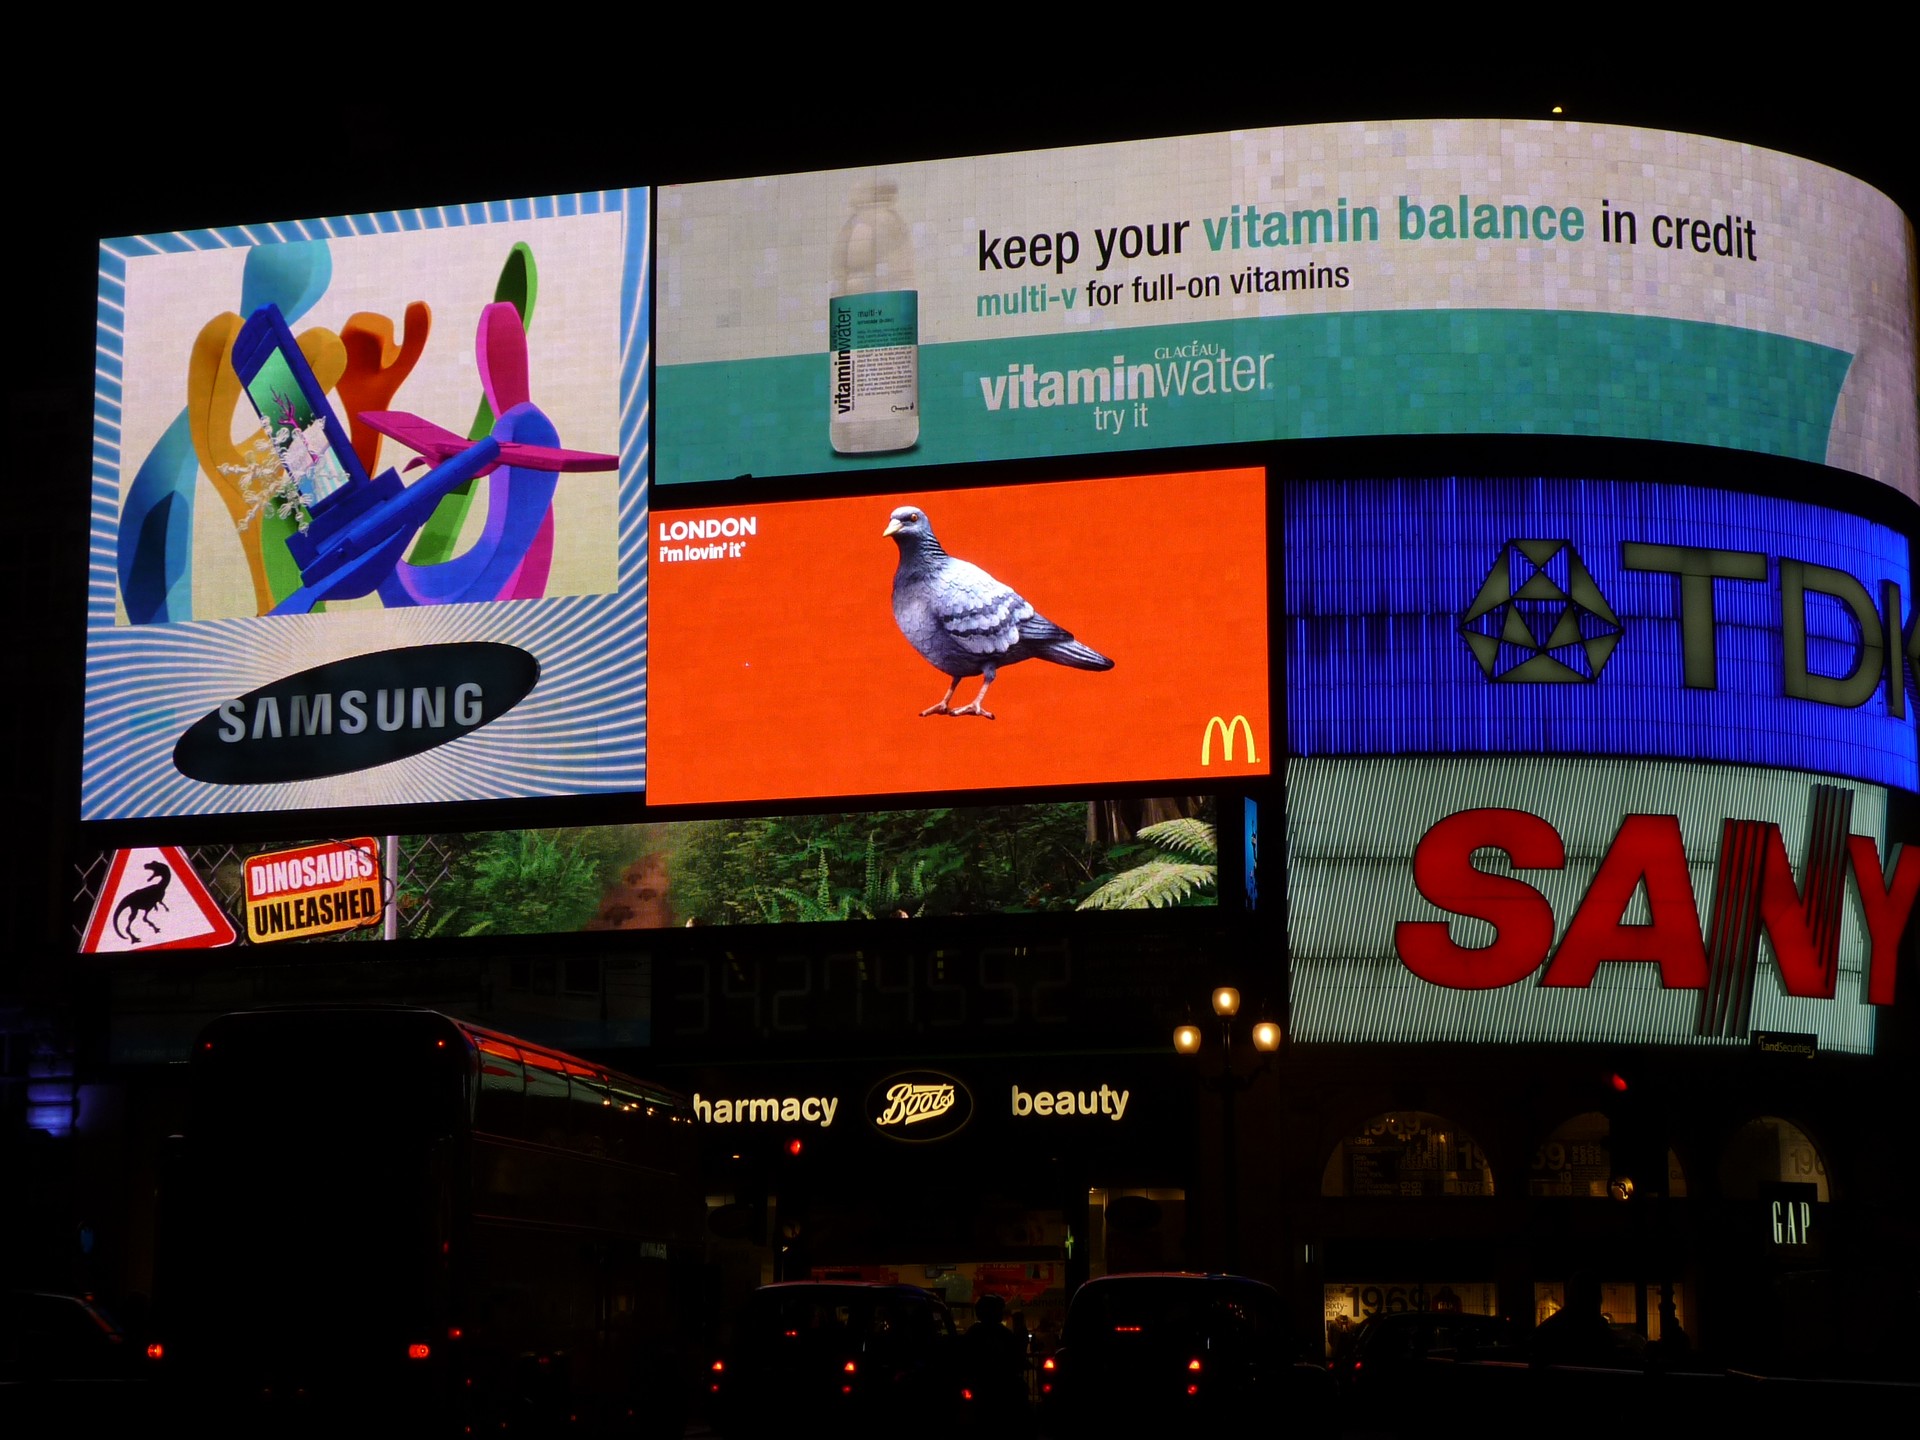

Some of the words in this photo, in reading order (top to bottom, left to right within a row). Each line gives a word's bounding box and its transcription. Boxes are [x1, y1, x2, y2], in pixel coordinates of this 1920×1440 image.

[978, 229, 1080, 274] keep
[1094, 220, 1190, 271] your
[1202, 197, 1379, 251] vitamin
[1398, 194, 1585, 242] balance
[1602, 199, 1637, 245] in
[1652, 215, 1757, 262] credit
[976, 283, 1077, 317] multi-v
[1086, 280, 1123, 307] for
[1131, 273, 1220, 303] full-on
[1230, 262, 1350, 294] vitamins
[1093, 405, 1125, 435] try
[1133, 402, 1149, 428] it
[659, 516, 757, 542] LONDON
[659, 545, 683, 562] i'm
[217, 682, 483, 743] SAMSUNG
[251, 846, 373, 896] DINOSAURS
[253, 887, 375, 936] UNLEASHED
[876, 1083, 955, 1126] Boots
[1012, 1083, 1129, 1121] beauty
[1771, 1201, 1811, 1245] GAP
